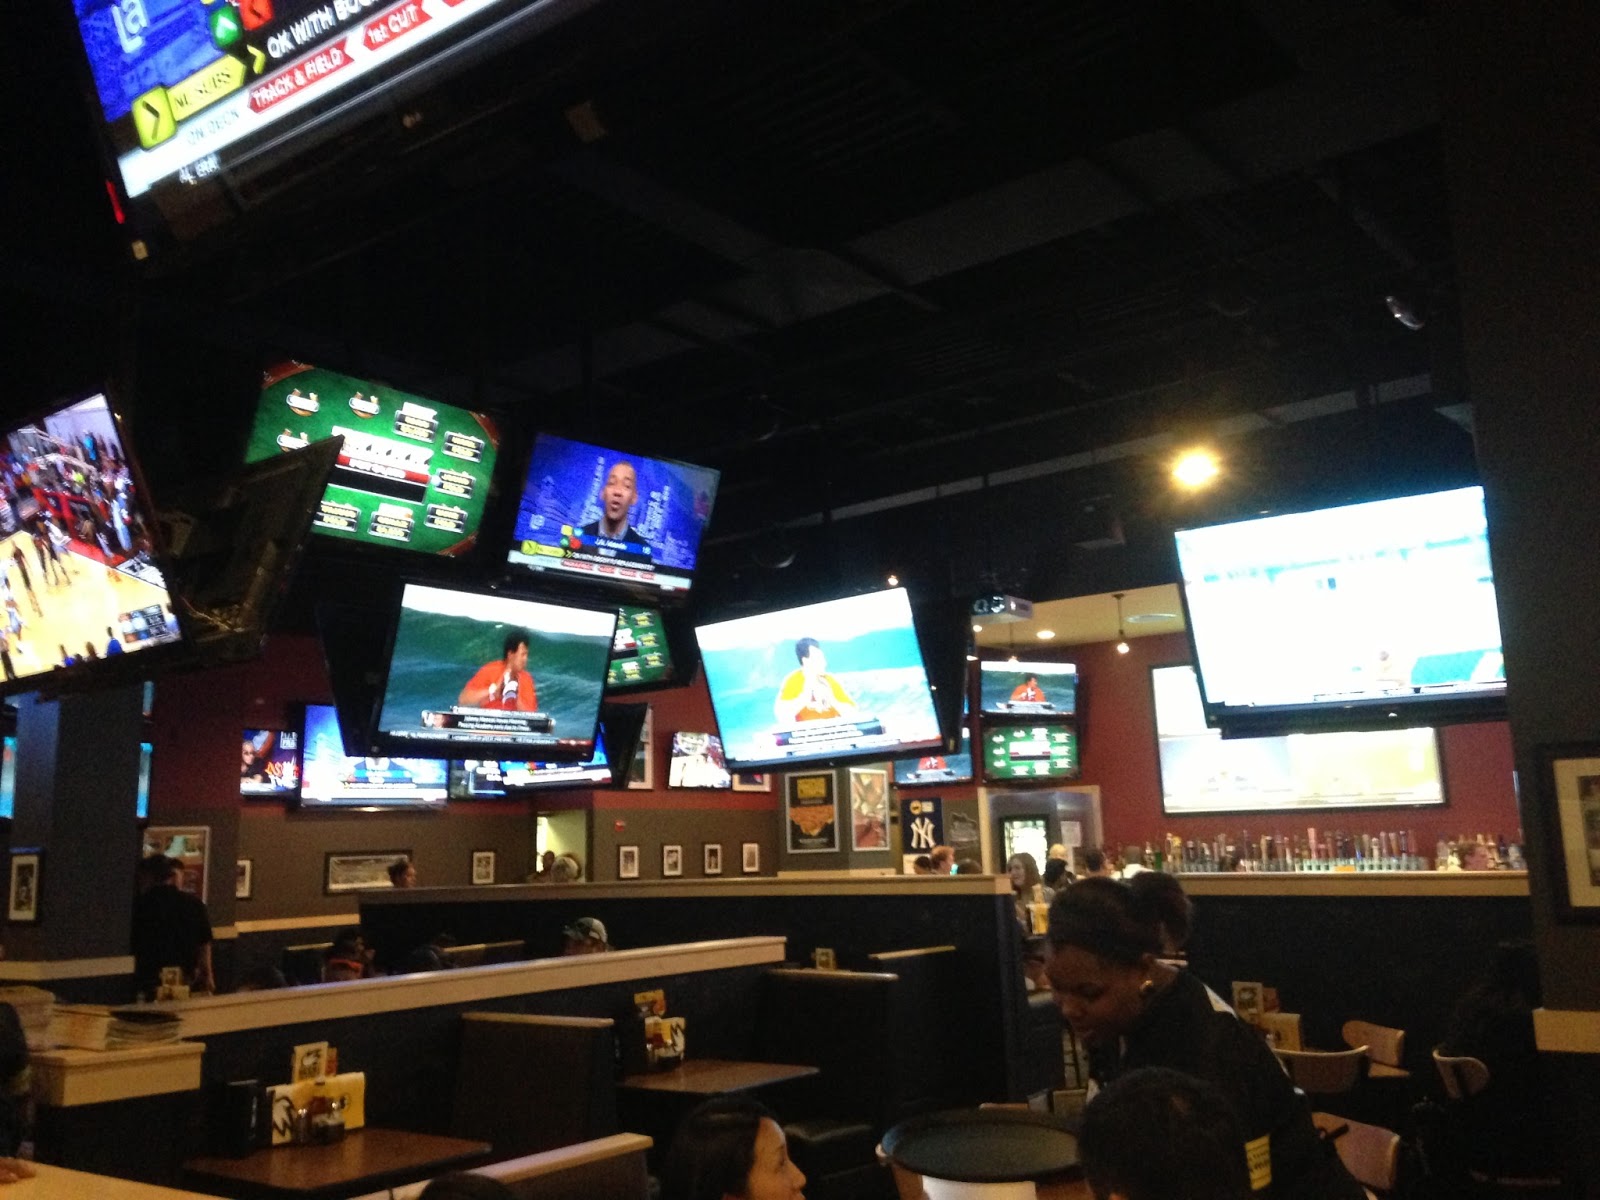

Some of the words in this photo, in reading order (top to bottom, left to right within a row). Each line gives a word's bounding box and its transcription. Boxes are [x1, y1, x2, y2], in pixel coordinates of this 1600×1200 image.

[267, 30, 295, 58] OK
[290, 5, 336, 46] WITH
[387, 4, 420, 33] CUT
[251, 75, 294, 108] TRACK
[304, 49, 344, 80] FIELD
[910, 816, 936, 849] NY
